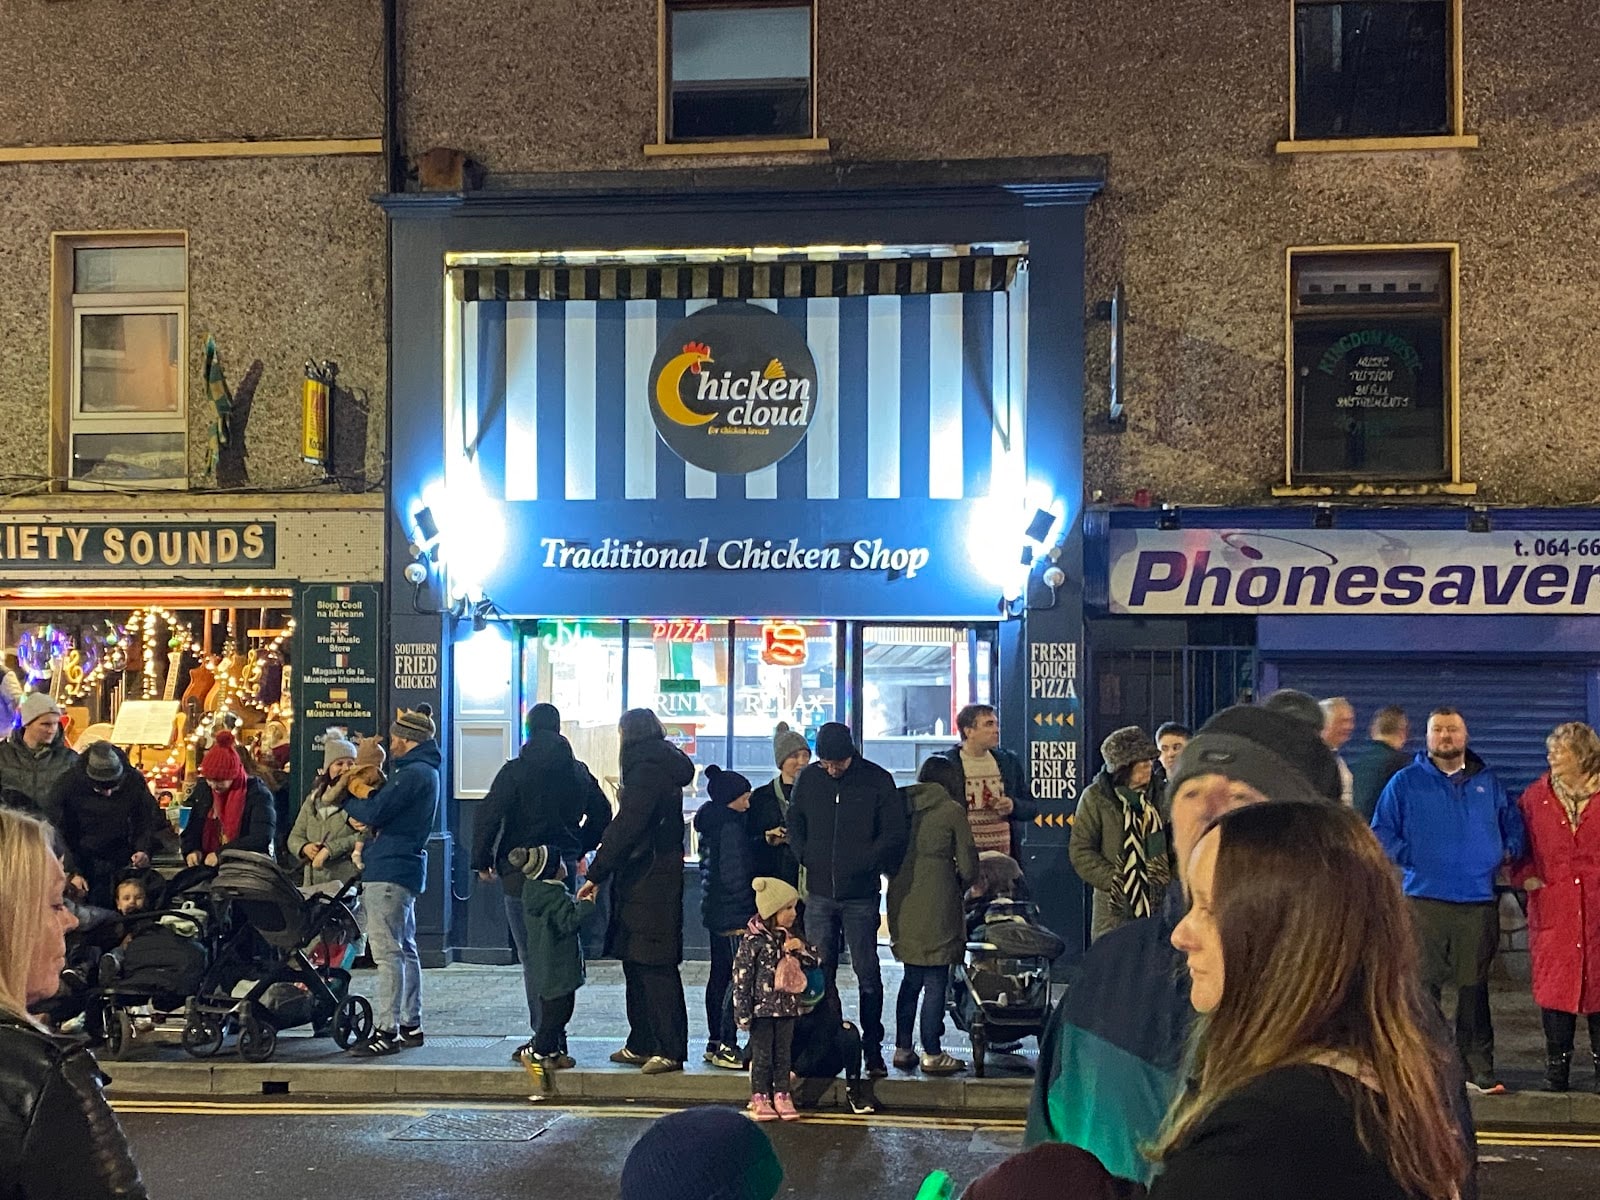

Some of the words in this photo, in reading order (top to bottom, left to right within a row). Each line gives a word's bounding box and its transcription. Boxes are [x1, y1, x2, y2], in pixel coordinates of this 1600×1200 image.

[656, 350, 810, 426] Chicken
[727, 400, 809, 426] cloud
[0, 525, 89, 561] IETY
[103, 524, 264, 566] SOUNDS
[540, 537, 709, 570] Traditional
[717, 537, 841, 571] Chicken
[850, 538, 930, 579] Shop
[317, 601, 340, 611] Siopa
[341, 601, 362, 610] Ceoil
[317, 635, 336, 644] Irish
[337, 635, 361, 644] Music
[653, 623, 708, 642] PIZZA
[329, 644, 351, 652] Store
[394, 643, 437, 655] SOUTHERN
[1031, 643, 1076, 662] FRESH
[312, 667, 345, 677] Magasin
[346, 667, 356, 675] de
[357, 667, 365, 675] la
[395, 655, 437, 675] FRIED
[1031, 661, 1076, 679] DOUGH
[304, 676, 337, 685] Musique
[338, 676, 375, 684] Irlandaise
[394, 675, 437, 689] CHICKEN
[1031, 679, 1077, 698] PIZZA
[306, 709, 334, 718] Música
[336, 709, 371, 717] Irlandesa
[314, 700, 341, 709] Tienda
[342, 700, 352, 709] de
[354, 700, 361, 709] la
[651, 692, 712, 717] RINK
[1031, 741, 1076, 761] FRESH
[1031, 760, 1061, 779] FISH
[1065, 761, 1077, 779] &
[1031, 778, 1077, 799] CHIPS
